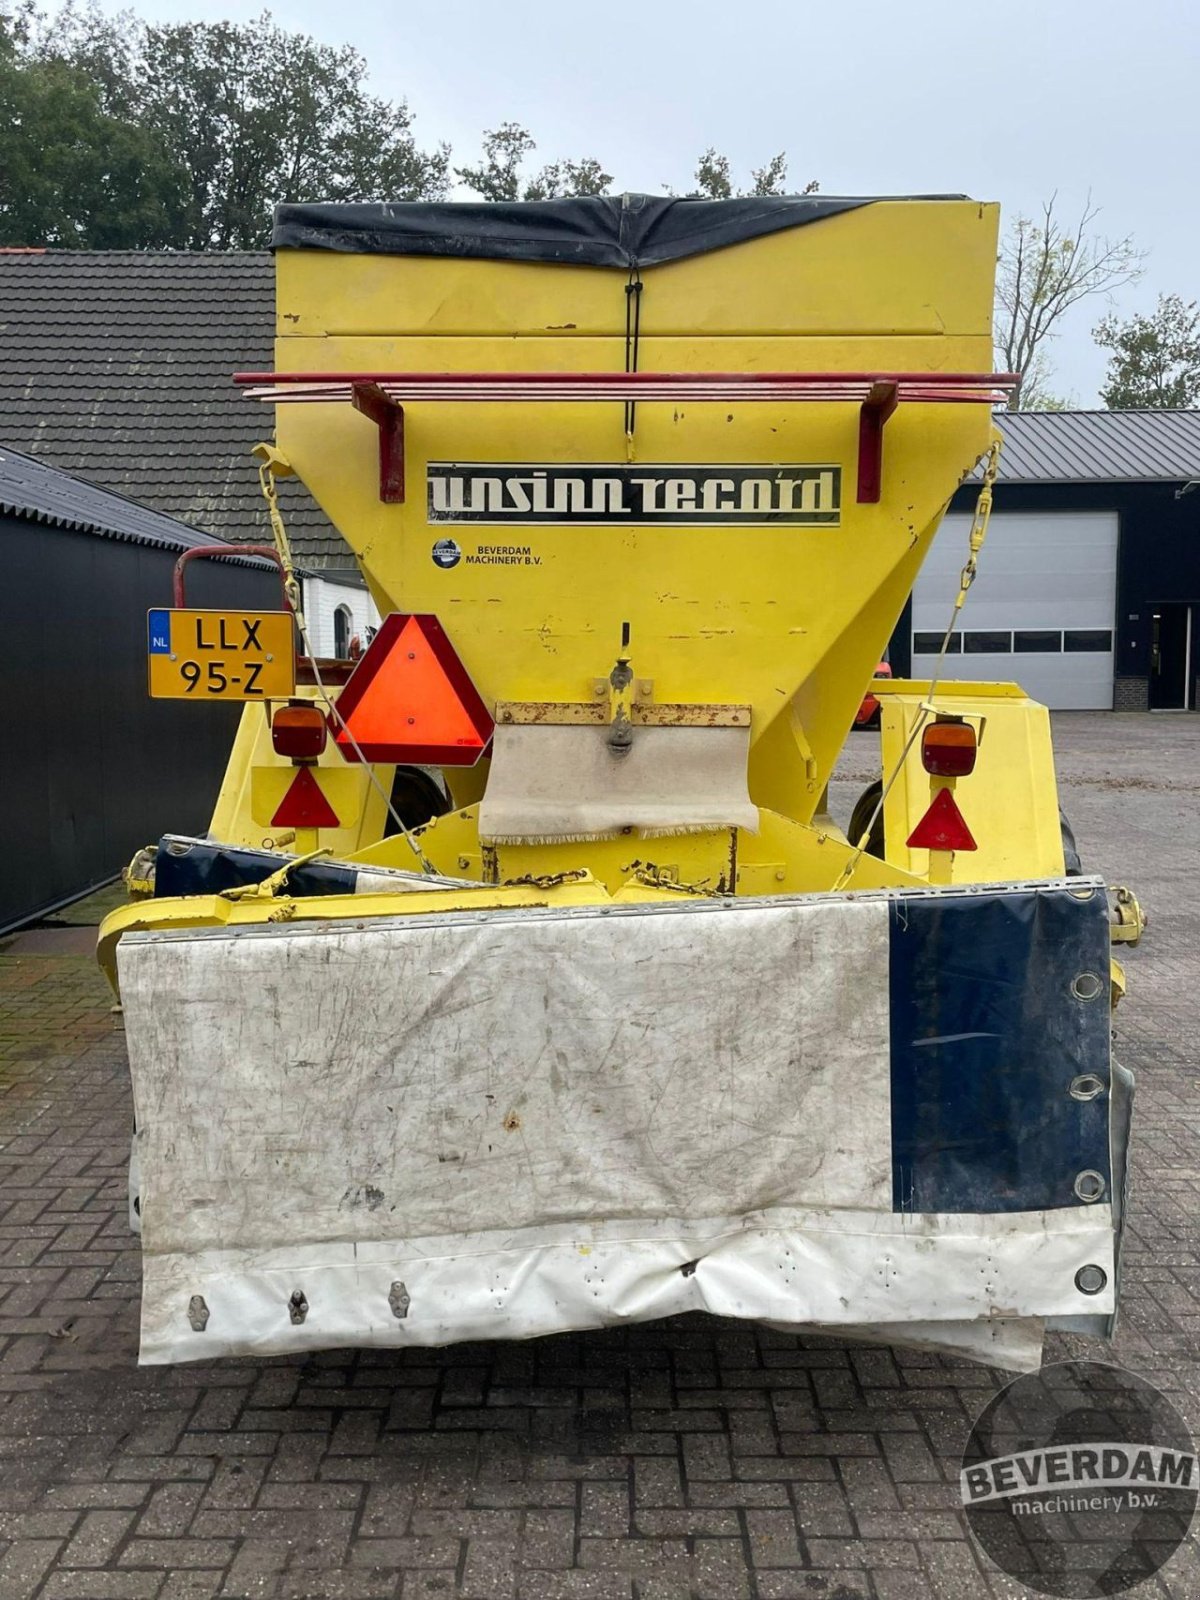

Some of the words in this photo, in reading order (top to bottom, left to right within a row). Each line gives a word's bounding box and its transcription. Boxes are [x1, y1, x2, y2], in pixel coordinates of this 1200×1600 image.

[427, 472, 631, 512] unsinn
[631, 472, 840, 513] record
[465, 555, 522, 565] MACHINERY
[524, 556, 543, 565] B.V.
[477, 546, 531, 555] BEVERDAM
[153, 637, 168, 647] NL
[196, 618, 262, 650] LLX
[180, 661, 264, 694] 95-Z
